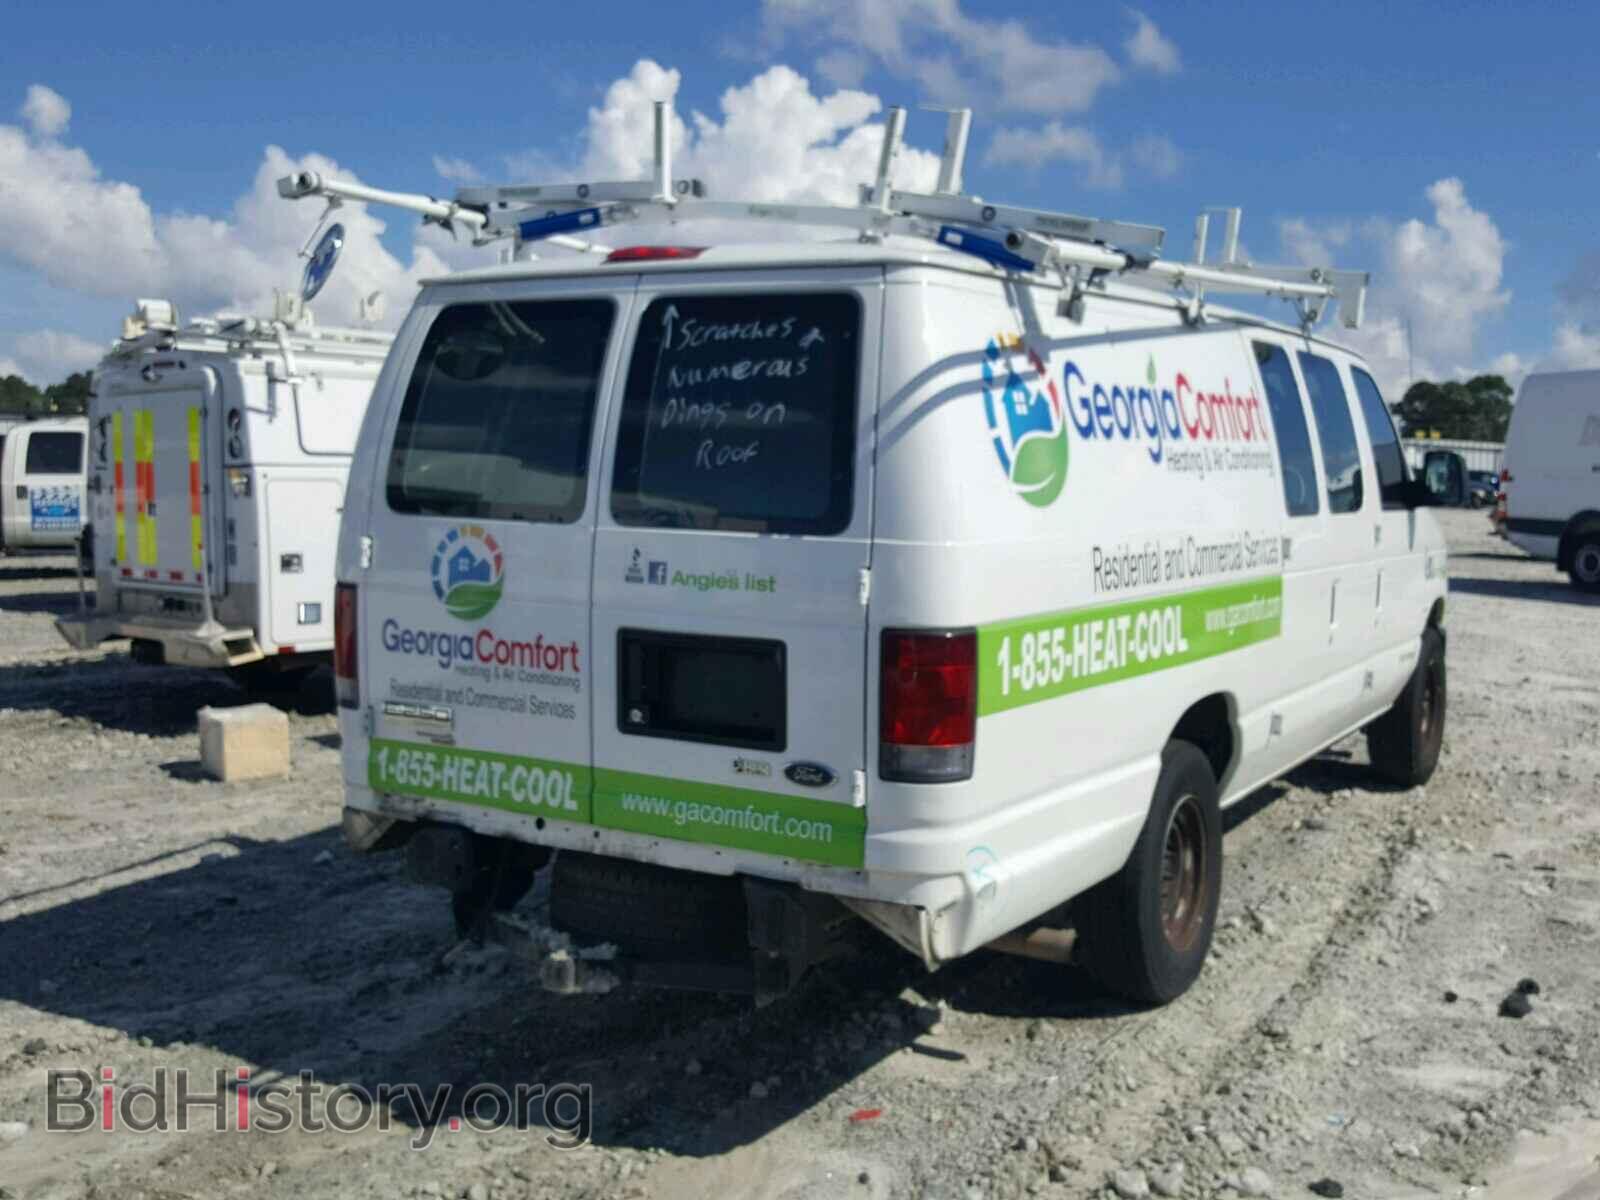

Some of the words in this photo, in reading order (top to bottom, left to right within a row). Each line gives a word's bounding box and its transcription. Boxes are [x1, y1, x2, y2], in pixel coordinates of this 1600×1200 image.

[680, 316, 799, 351] Scratches
[660, 397, 731, 430] Dings
[745, 402, 787, 425] on
[695, 439, 760, 470] Roof
[1092, 540, 1161, 592] Residential
[1164, 537, 1184, 582] and
[997, 605, 1189, 696] 1-855-HEAT-COOL
[529, 694, 577, 720] Services
[378, 746, 579, 811] 1-855-HEAT-COOL
[621, 793, 833, 843] www.gacomfort.com
